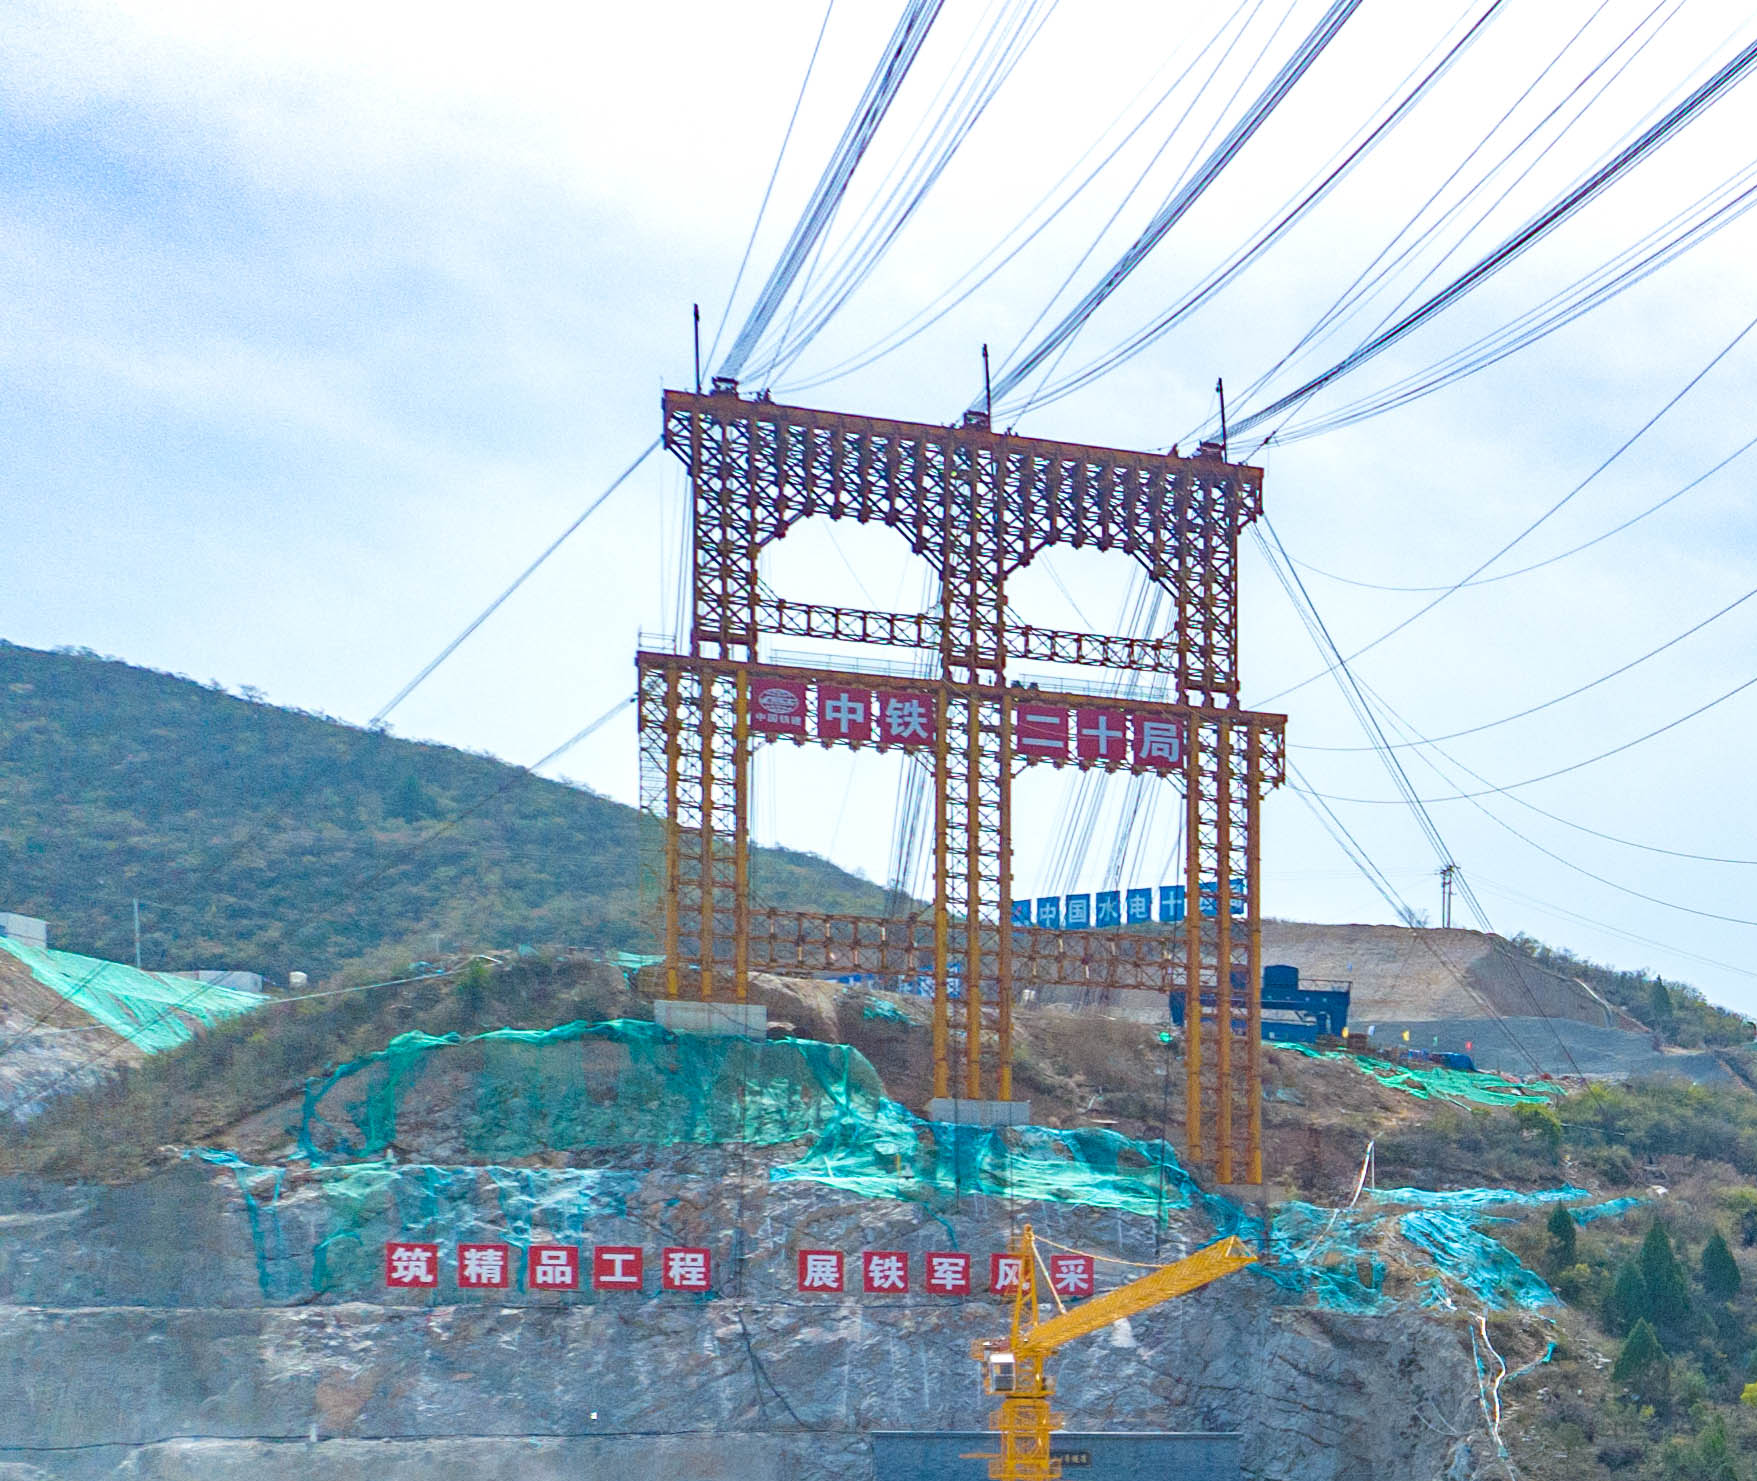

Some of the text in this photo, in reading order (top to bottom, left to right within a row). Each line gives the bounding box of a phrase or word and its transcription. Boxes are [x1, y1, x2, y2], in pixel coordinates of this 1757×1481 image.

[391, 1247, 1090, 1292] 筑精品工程 展铁军风采
